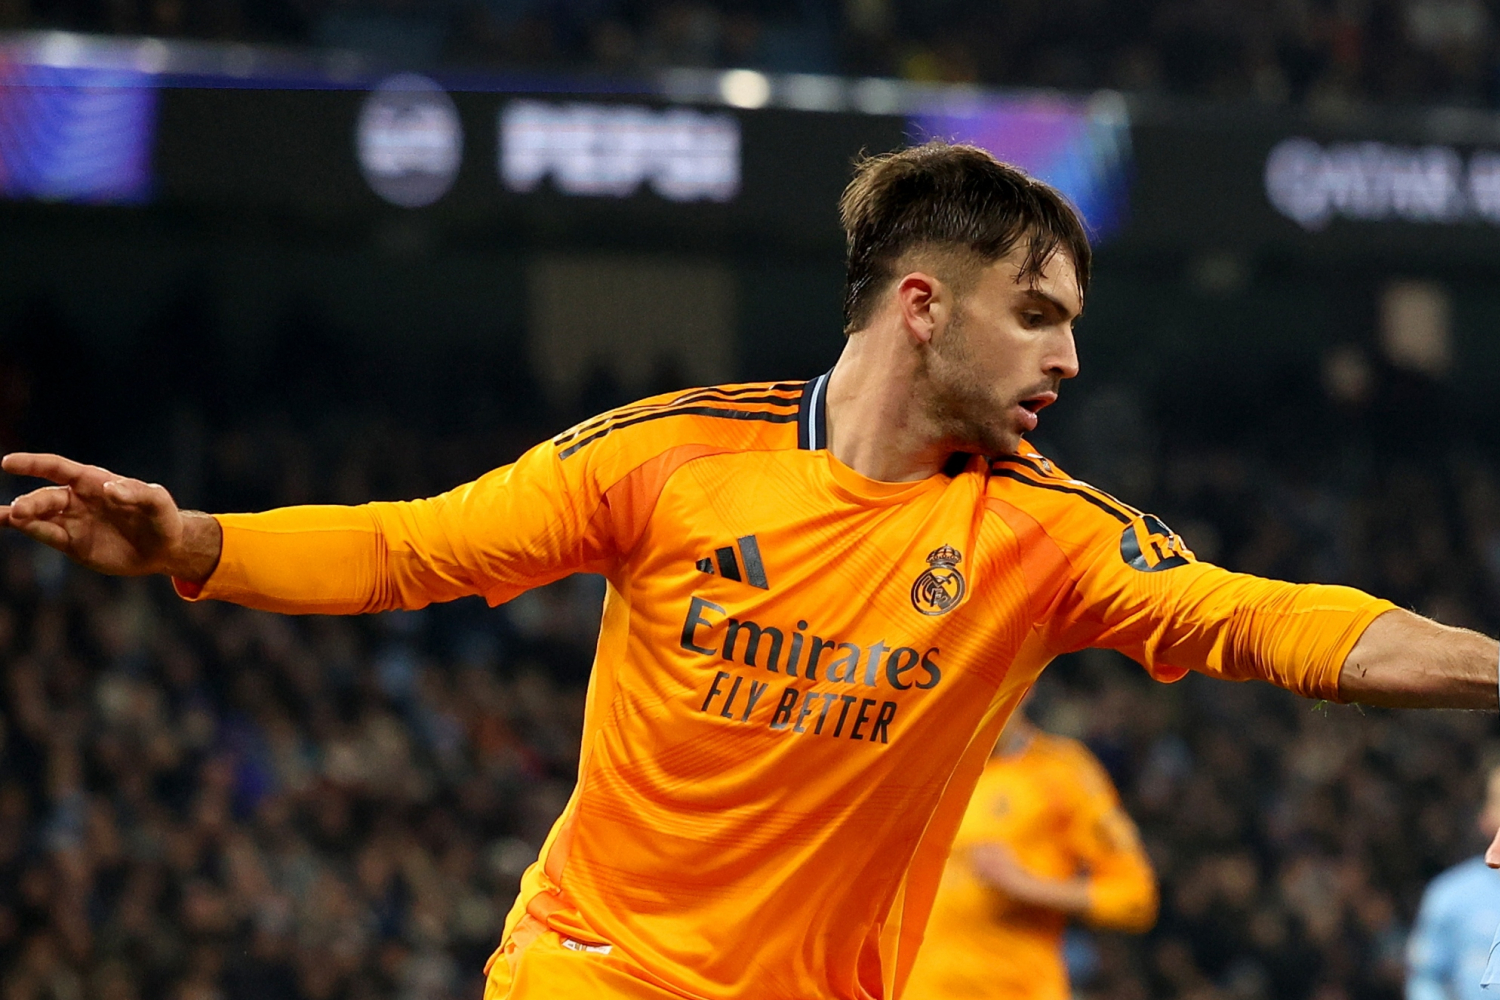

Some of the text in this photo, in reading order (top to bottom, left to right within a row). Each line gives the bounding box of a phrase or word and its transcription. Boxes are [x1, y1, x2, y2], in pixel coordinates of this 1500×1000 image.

[499, 101, 741, 202] PEPSI
[680, 595, 942, 691] Emirates
[701, 670, 898, 744] FLY BETTER
